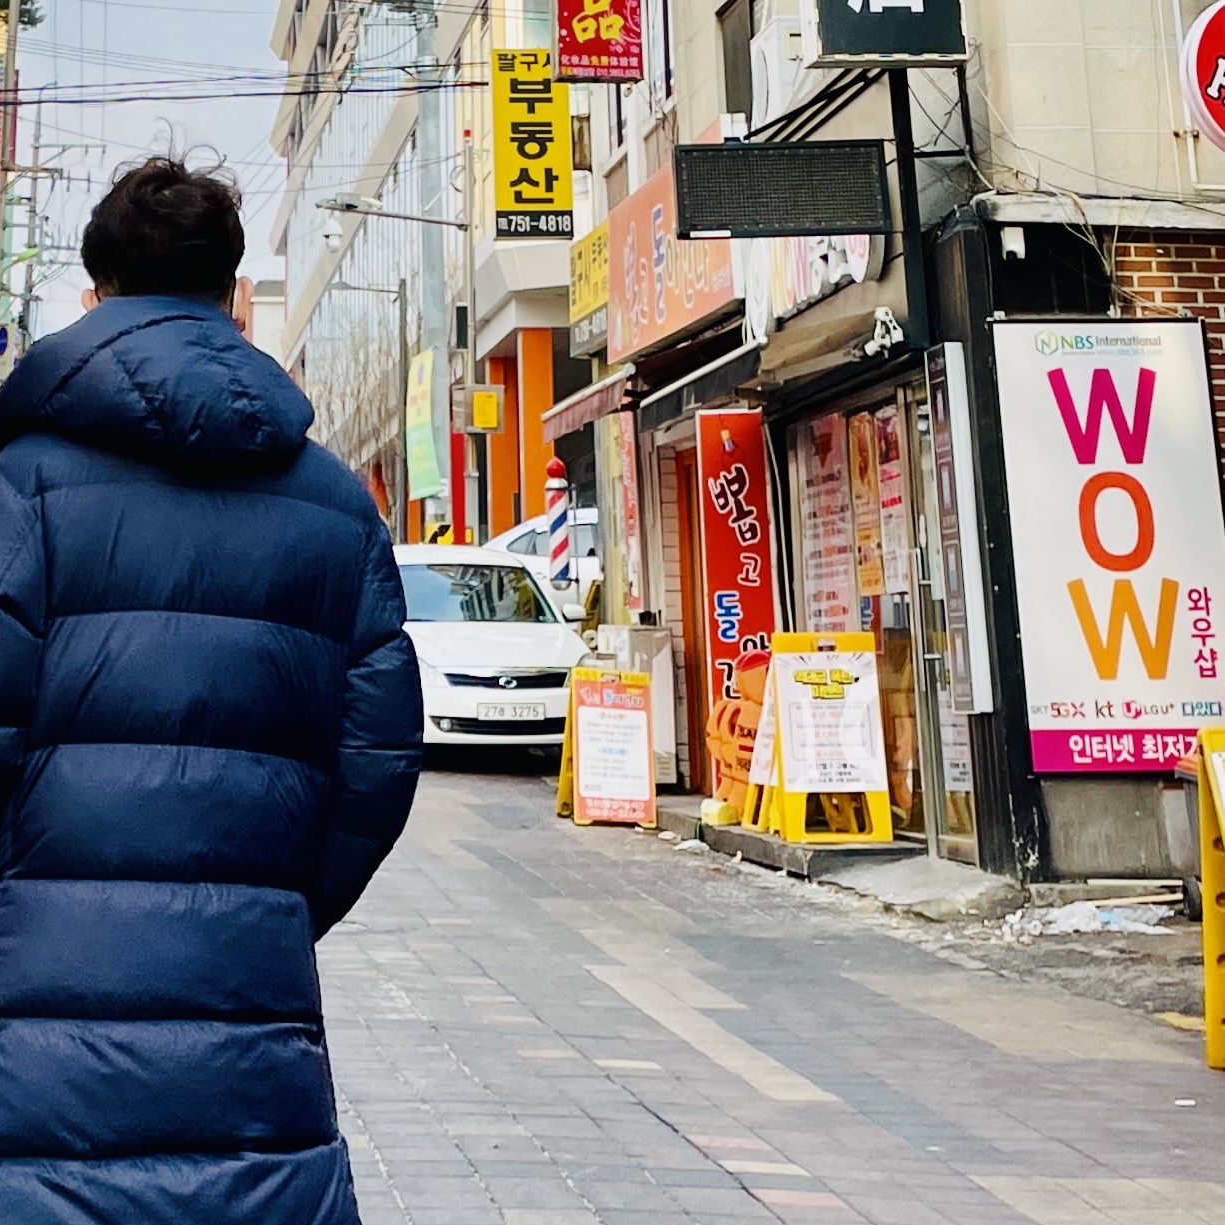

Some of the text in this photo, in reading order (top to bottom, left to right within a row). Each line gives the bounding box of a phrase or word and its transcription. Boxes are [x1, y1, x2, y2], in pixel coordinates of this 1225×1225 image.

[509, 78, 559, 204] 부동산
[508, 215, 571, 233] 751-4818
[1061, 335, 1162, 350] NBS International
[1047, 368, 1179, 680] WOW
[1187, 587, 1218, 678] 와우샵
[1095, 700, 1115, 718] kt
[1182, 701, 1222, 717] 다있다
[1069, 734, 1135, 764] 인터넷
